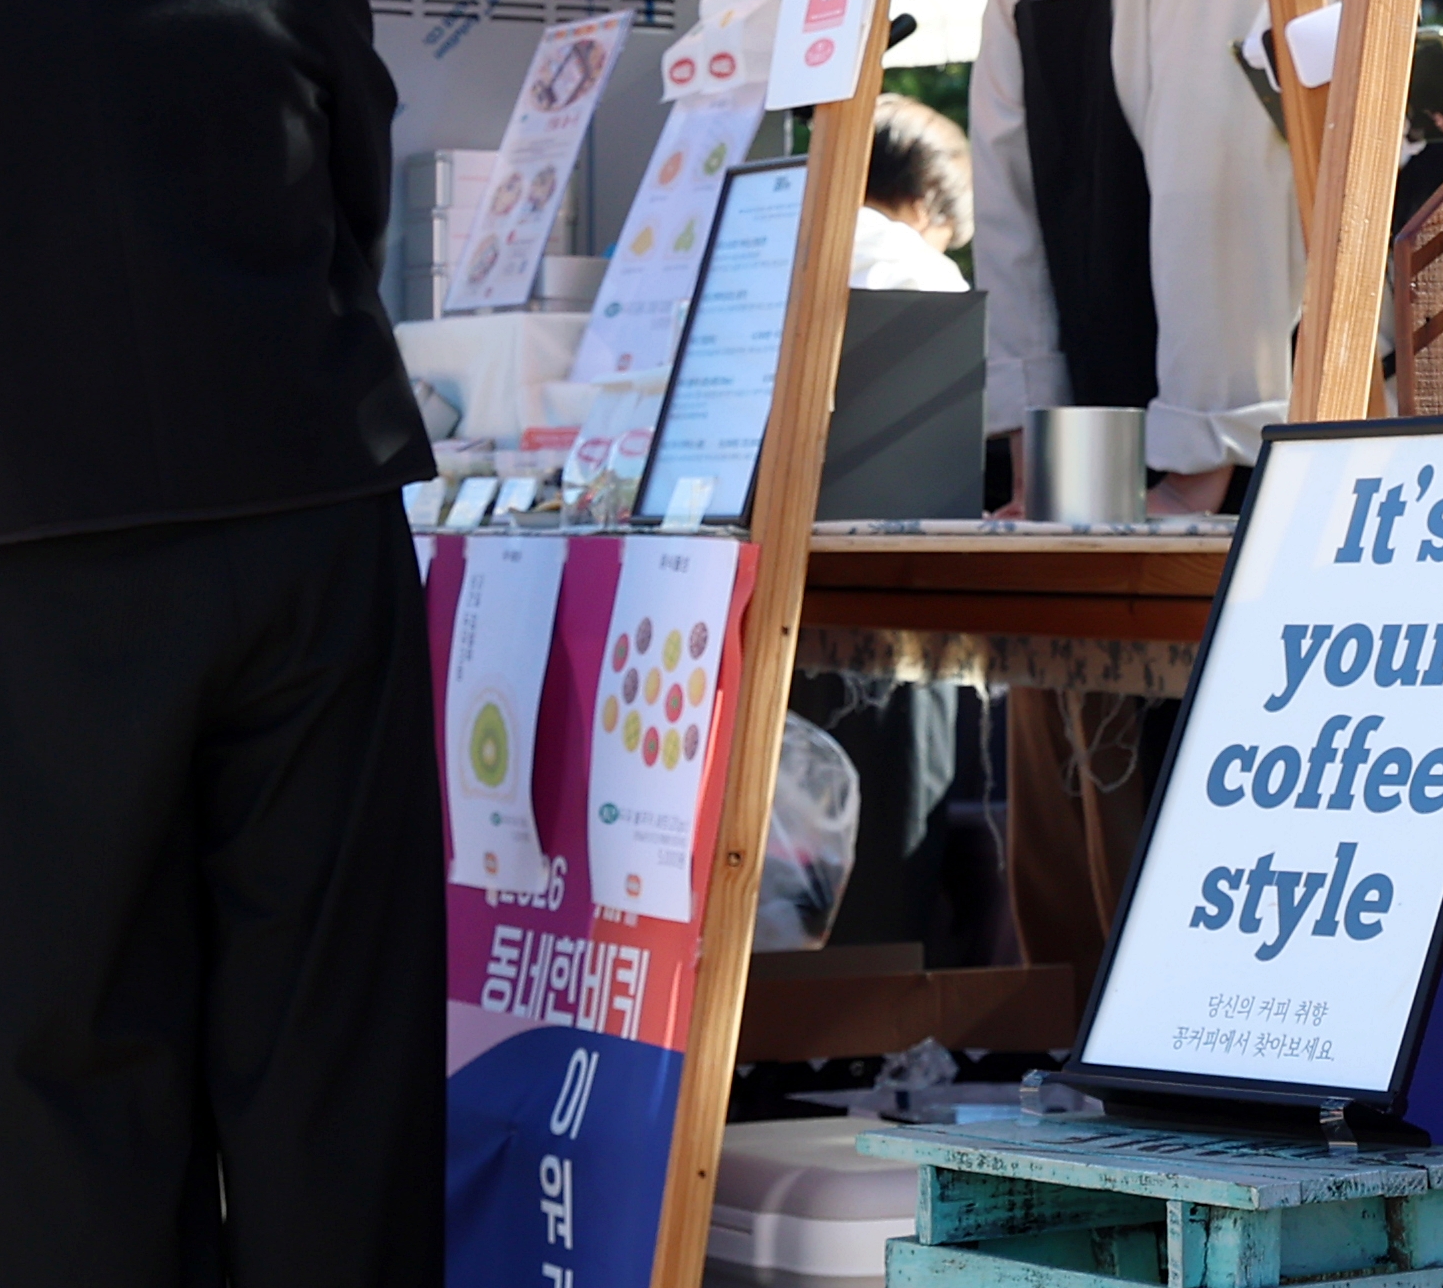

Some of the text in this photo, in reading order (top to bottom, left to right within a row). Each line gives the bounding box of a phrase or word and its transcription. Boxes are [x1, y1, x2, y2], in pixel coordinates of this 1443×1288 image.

[1188, 842, 1395, 962] style
[480, 923, 651, 1042] 동네한바퀴
[1208, 993, 1330, 1027] 당신의 커피 취향
